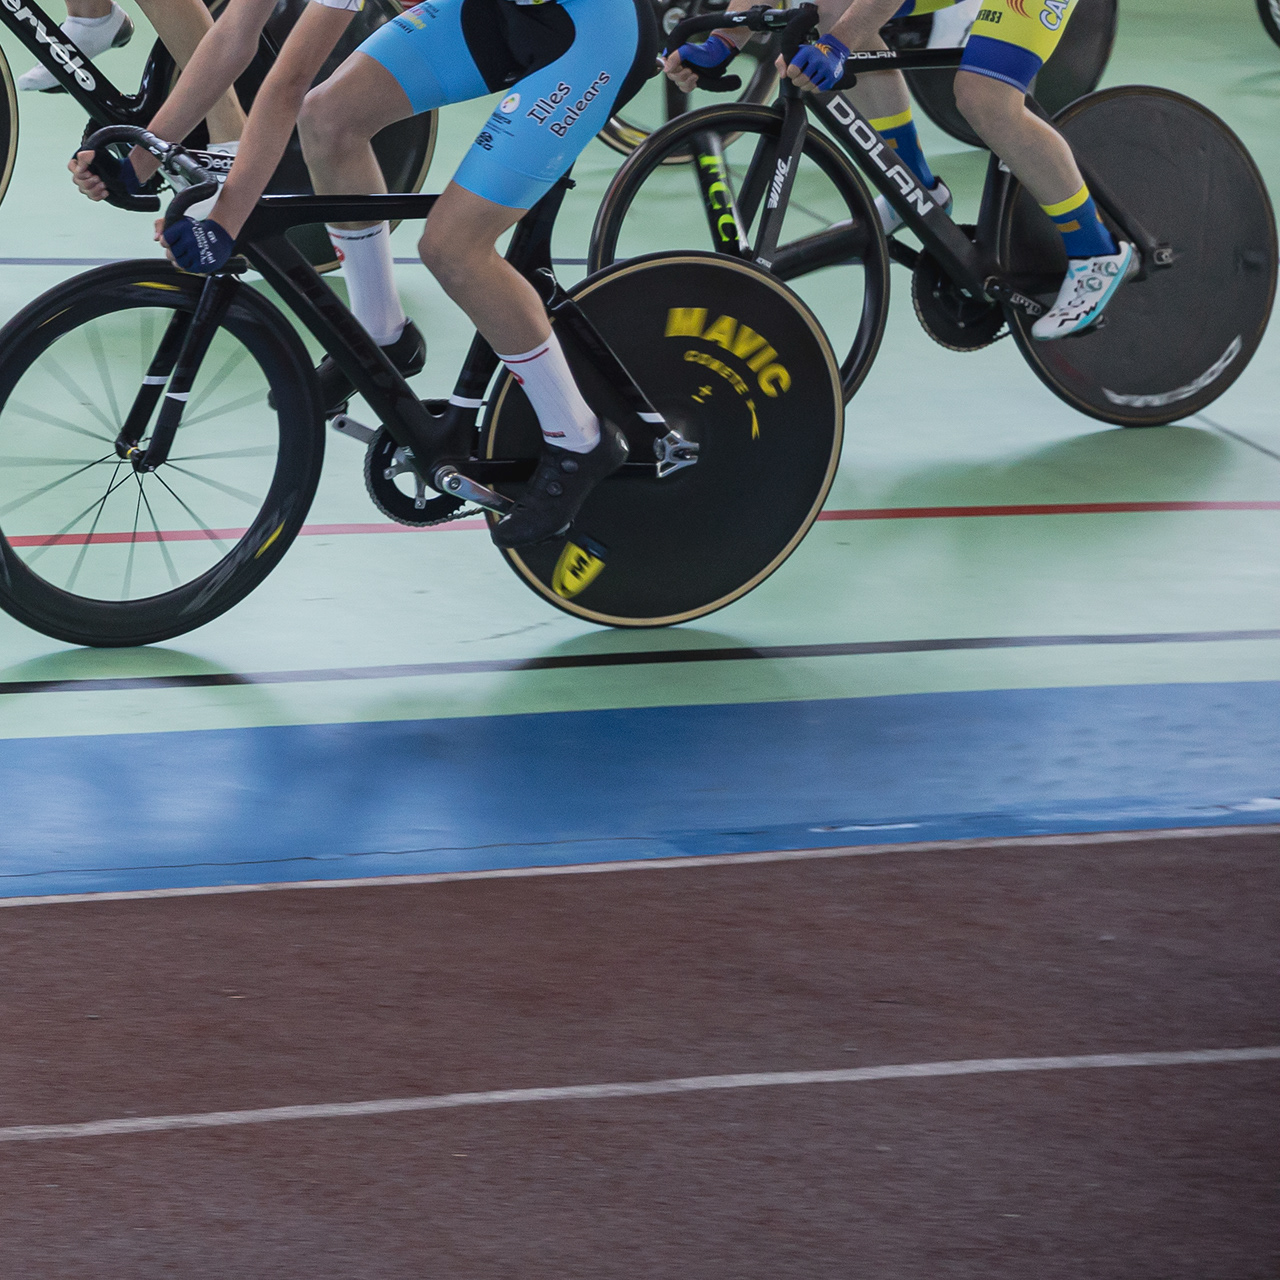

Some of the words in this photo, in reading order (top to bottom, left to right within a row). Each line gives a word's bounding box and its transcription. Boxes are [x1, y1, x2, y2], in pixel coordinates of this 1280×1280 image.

[847, 50, 897, 60] DOLAN
[526, 81, 572, 127] Illes
[548, 70, 612, 139] Balears
[766, 157, 788, 210] WING
[826, 94, 935, 217] DOLAN
[663, 307, 792, 398] MAVIC
